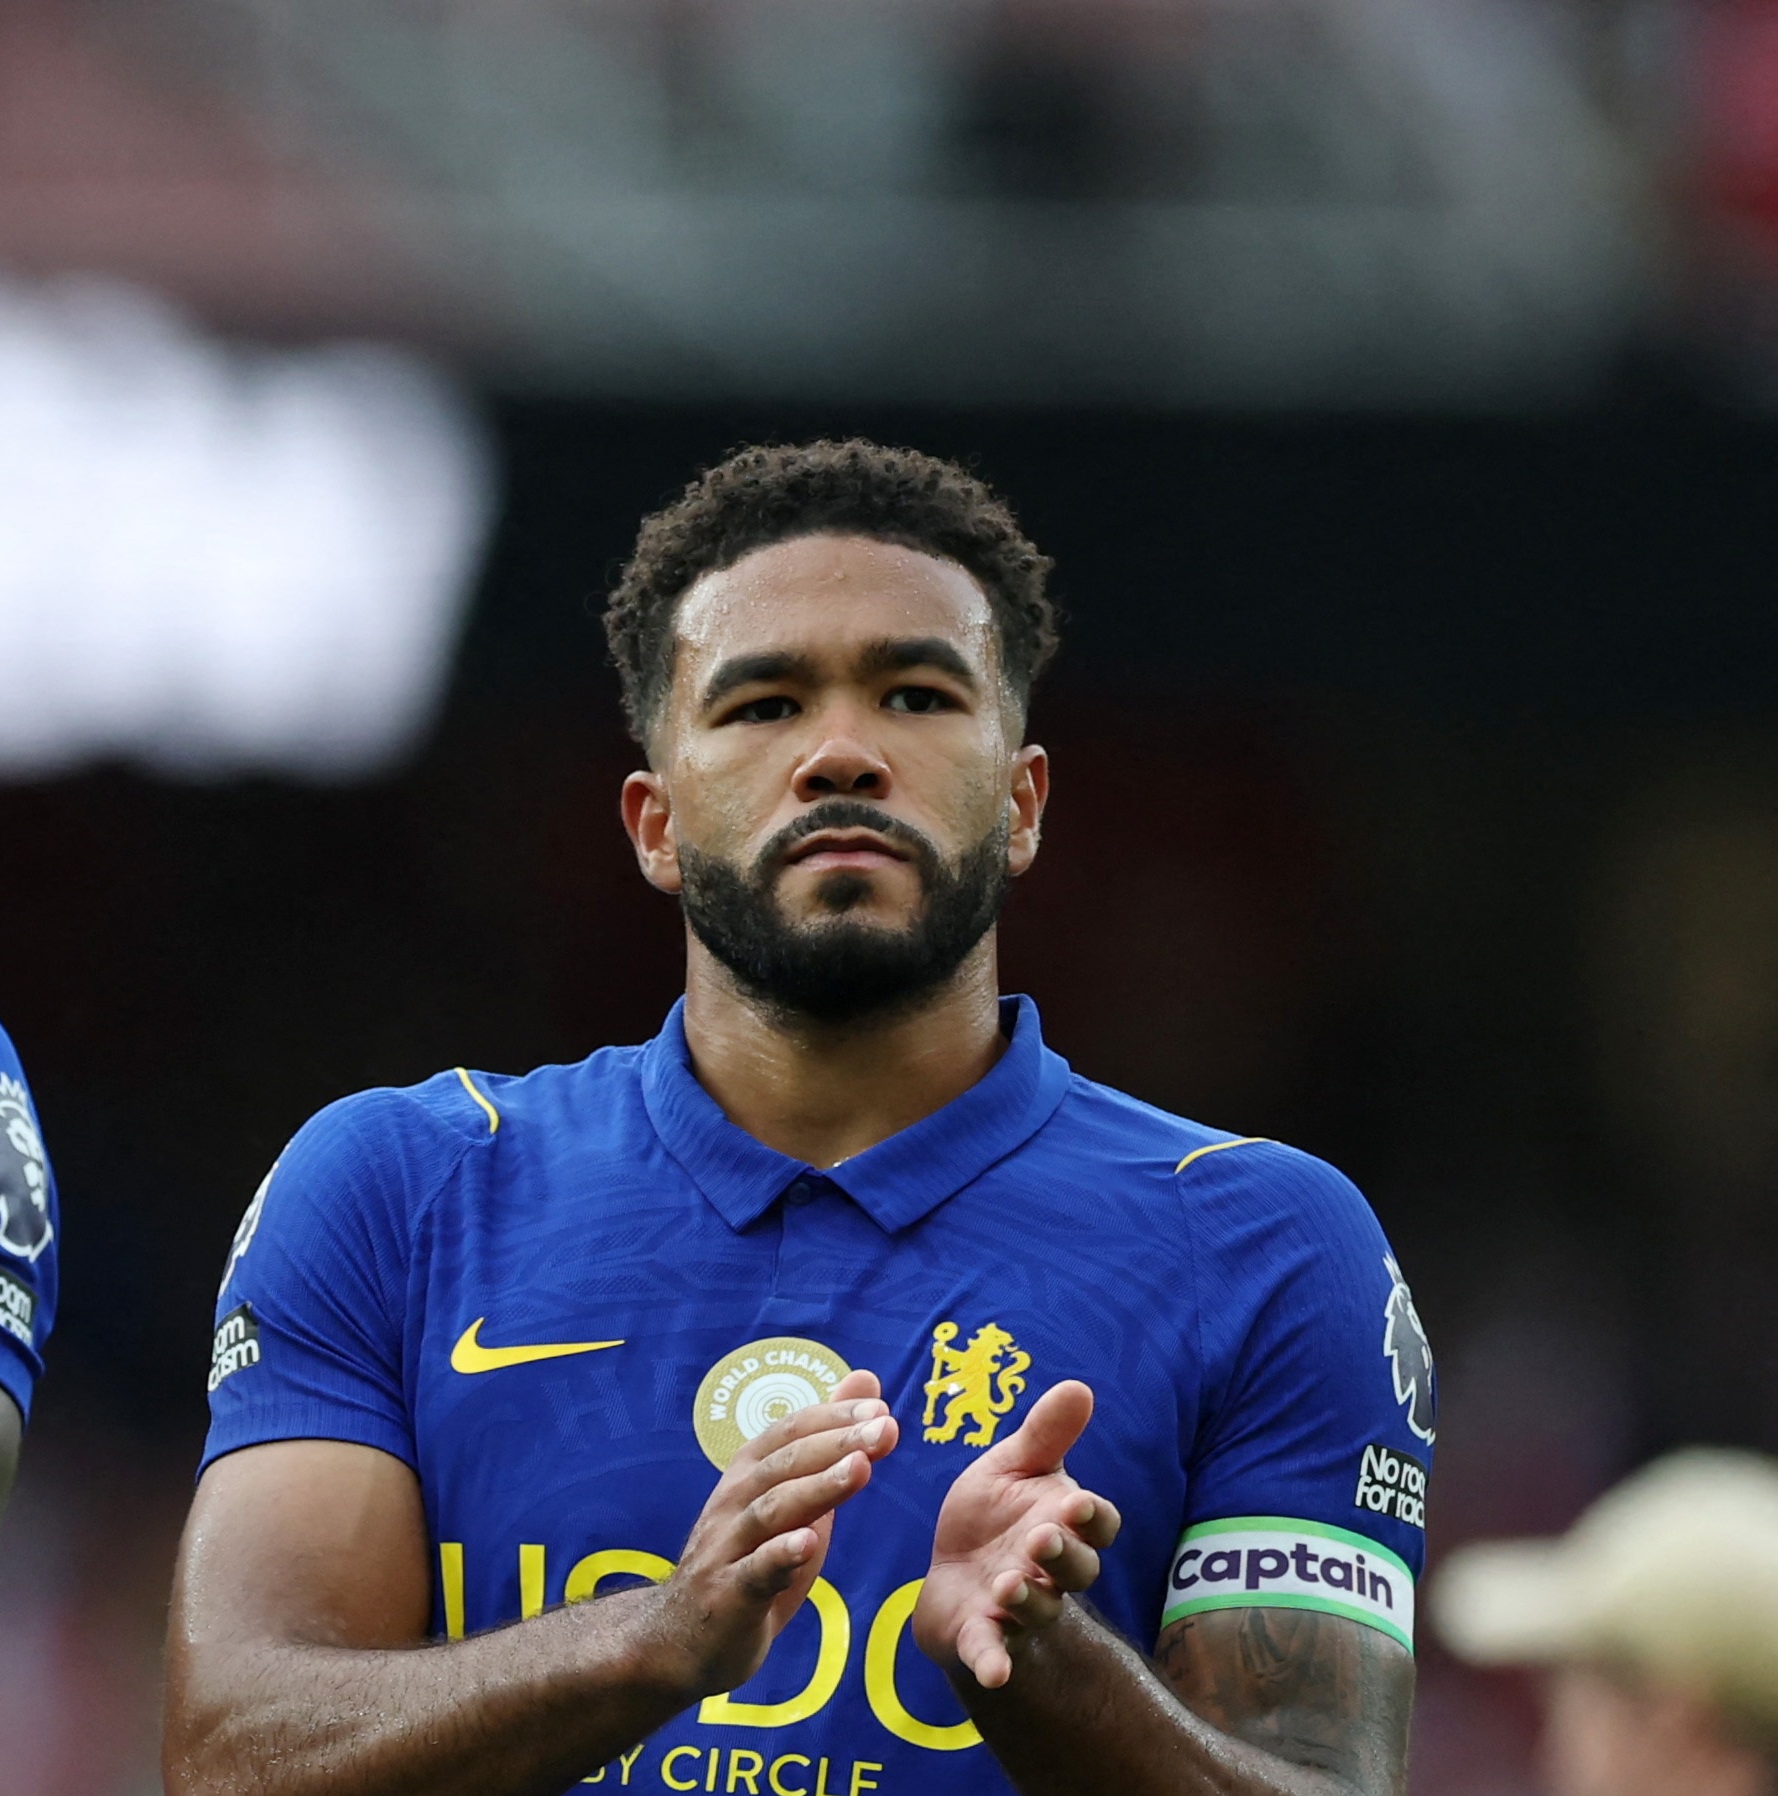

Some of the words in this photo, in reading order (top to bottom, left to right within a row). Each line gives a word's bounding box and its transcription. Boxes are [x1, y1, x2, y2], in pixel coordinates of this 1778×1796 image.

[709, 1357, 761, 1421] WORLD
[764, 1350, 839, 1393] CHAMPI
[1355, 1474, 1396, 1514] for
[1395, 1491, 1425, 1530] rac
[1360, 1444, 1400, 1485] No
[1400, 1462, 1426, 1500] roo
[1172, 1542, 1394, 1610] Captain
[439, 1542, 984, 1751] UDC
[580, 1744, 644, 1785] Y
